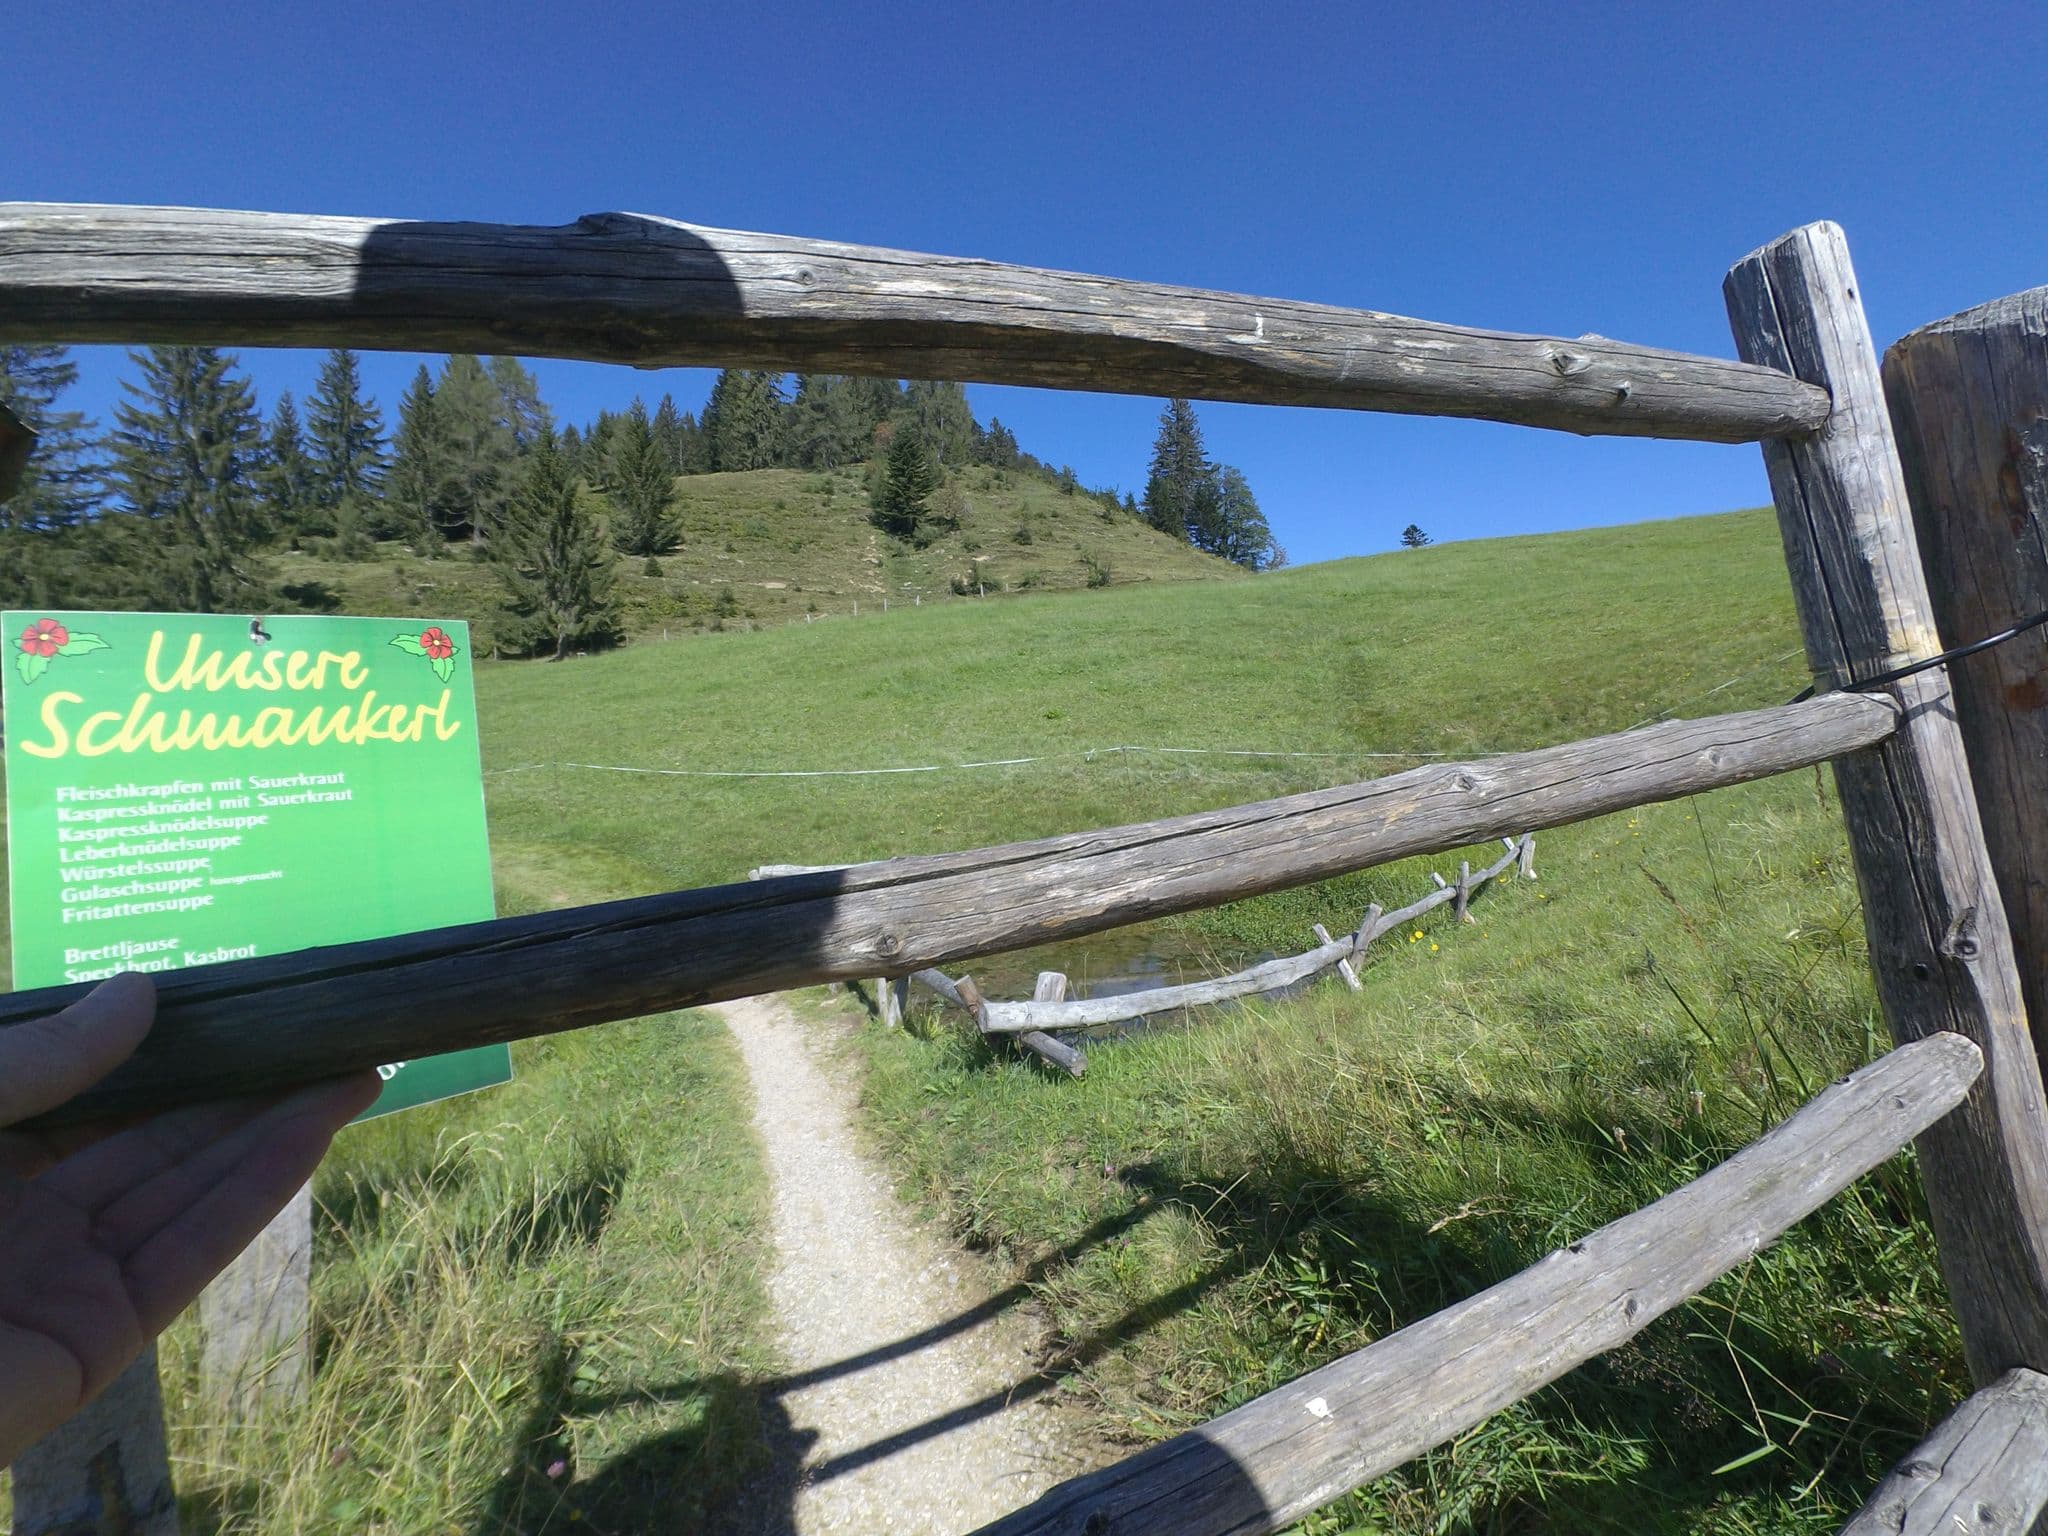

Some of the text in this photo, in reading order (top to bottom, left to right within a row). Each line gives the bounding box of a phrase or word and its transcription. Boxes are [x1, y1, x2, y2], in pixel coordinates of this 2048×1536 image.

[144, 630, 369, 693] Unsere
[20, 689, 461, 759] Schmankerl
[56, 771, 345, 802] Fleischkrapfen mit Sauerkraut
[57, 788, 353, 823] Kaspressknödel mit Sauerkraut
[58, 813, 269, 842] Kaspressknödelsuppe
[60, 834, 242, 863] Leberknödelsuppe
[61, 875, 203, 903] Gulaschsuppe
[62, 893, 214, 923] Fritattensuppe
[64, 937, 179, 965] Brettljause
[185, 944, 256, 967] Kasbrot
